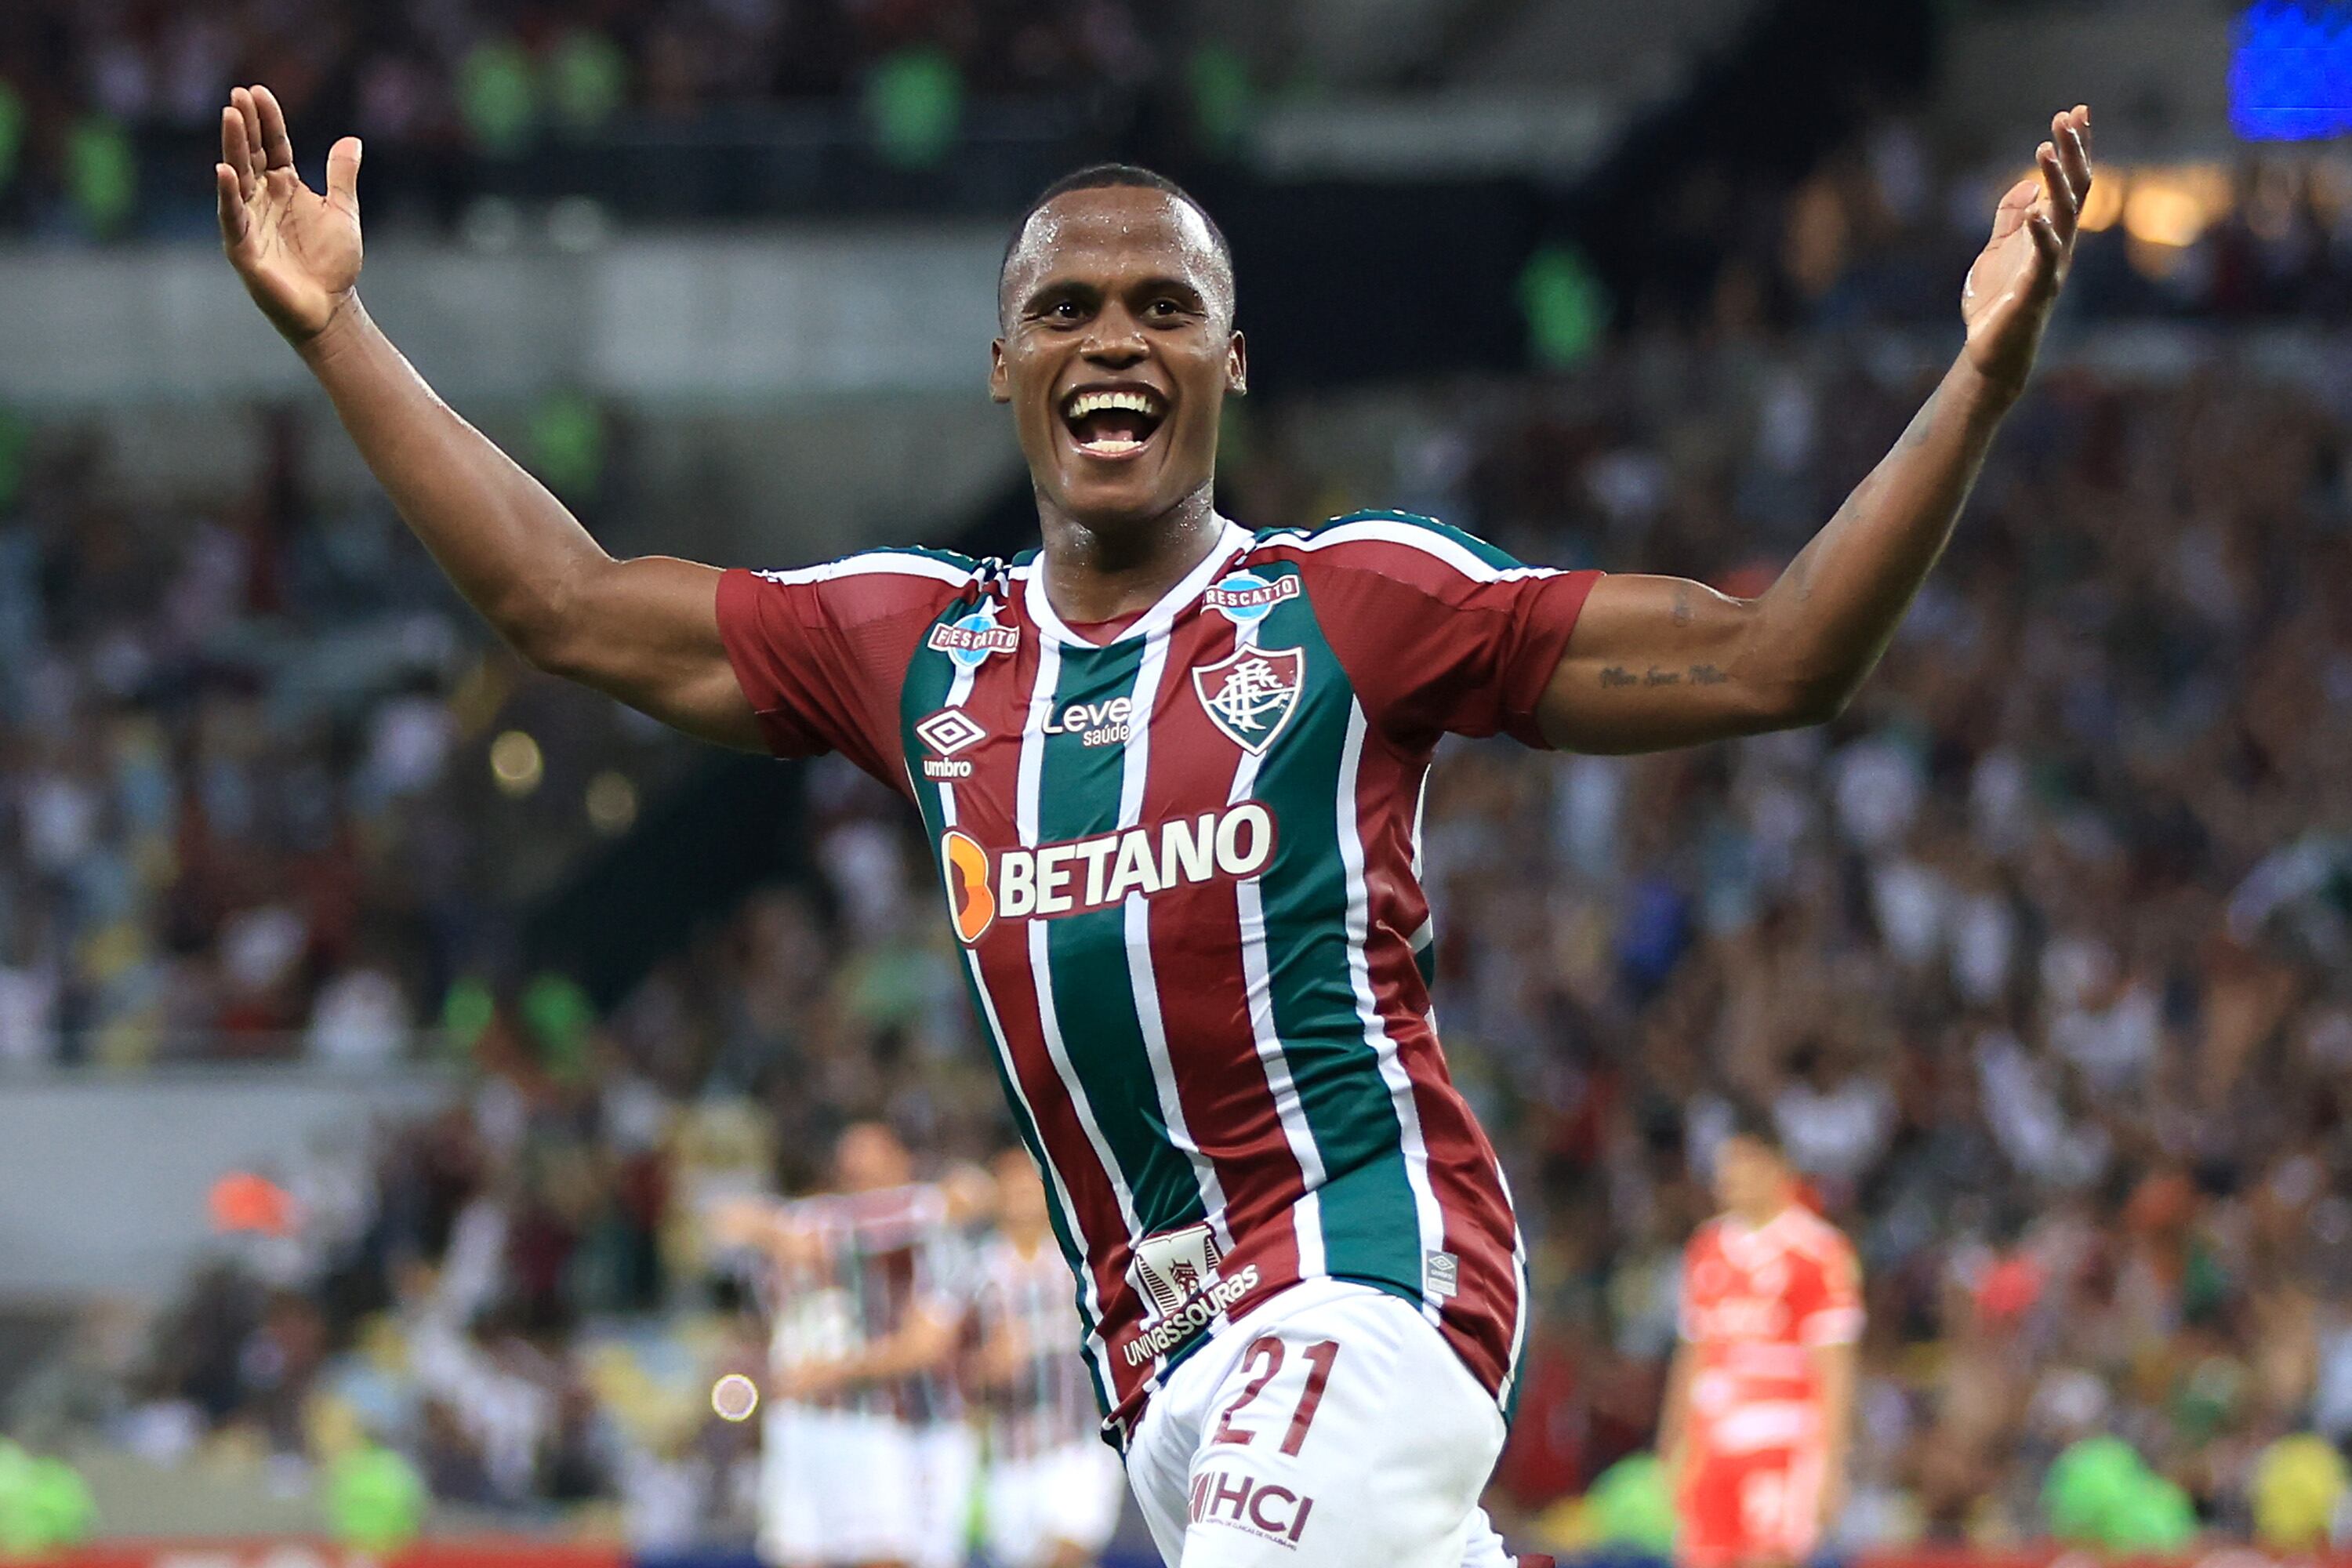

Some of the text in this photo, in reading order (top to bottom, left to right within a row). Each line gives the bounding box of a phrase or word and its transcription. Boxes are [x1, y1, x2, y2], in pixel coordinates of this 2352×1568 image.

[1205, 579, 1294, 607] RESCATTO
[1042, 696, 1131, 734] Leve
[1083, 722, 1130, 746] saúde
[924, 757, 972, 779] umbro
[999, 804, 1272, 918] BETANO
[1211, 1336, 1340, 1458] 21
[1209, 1471, 1314, 1543] HCI
